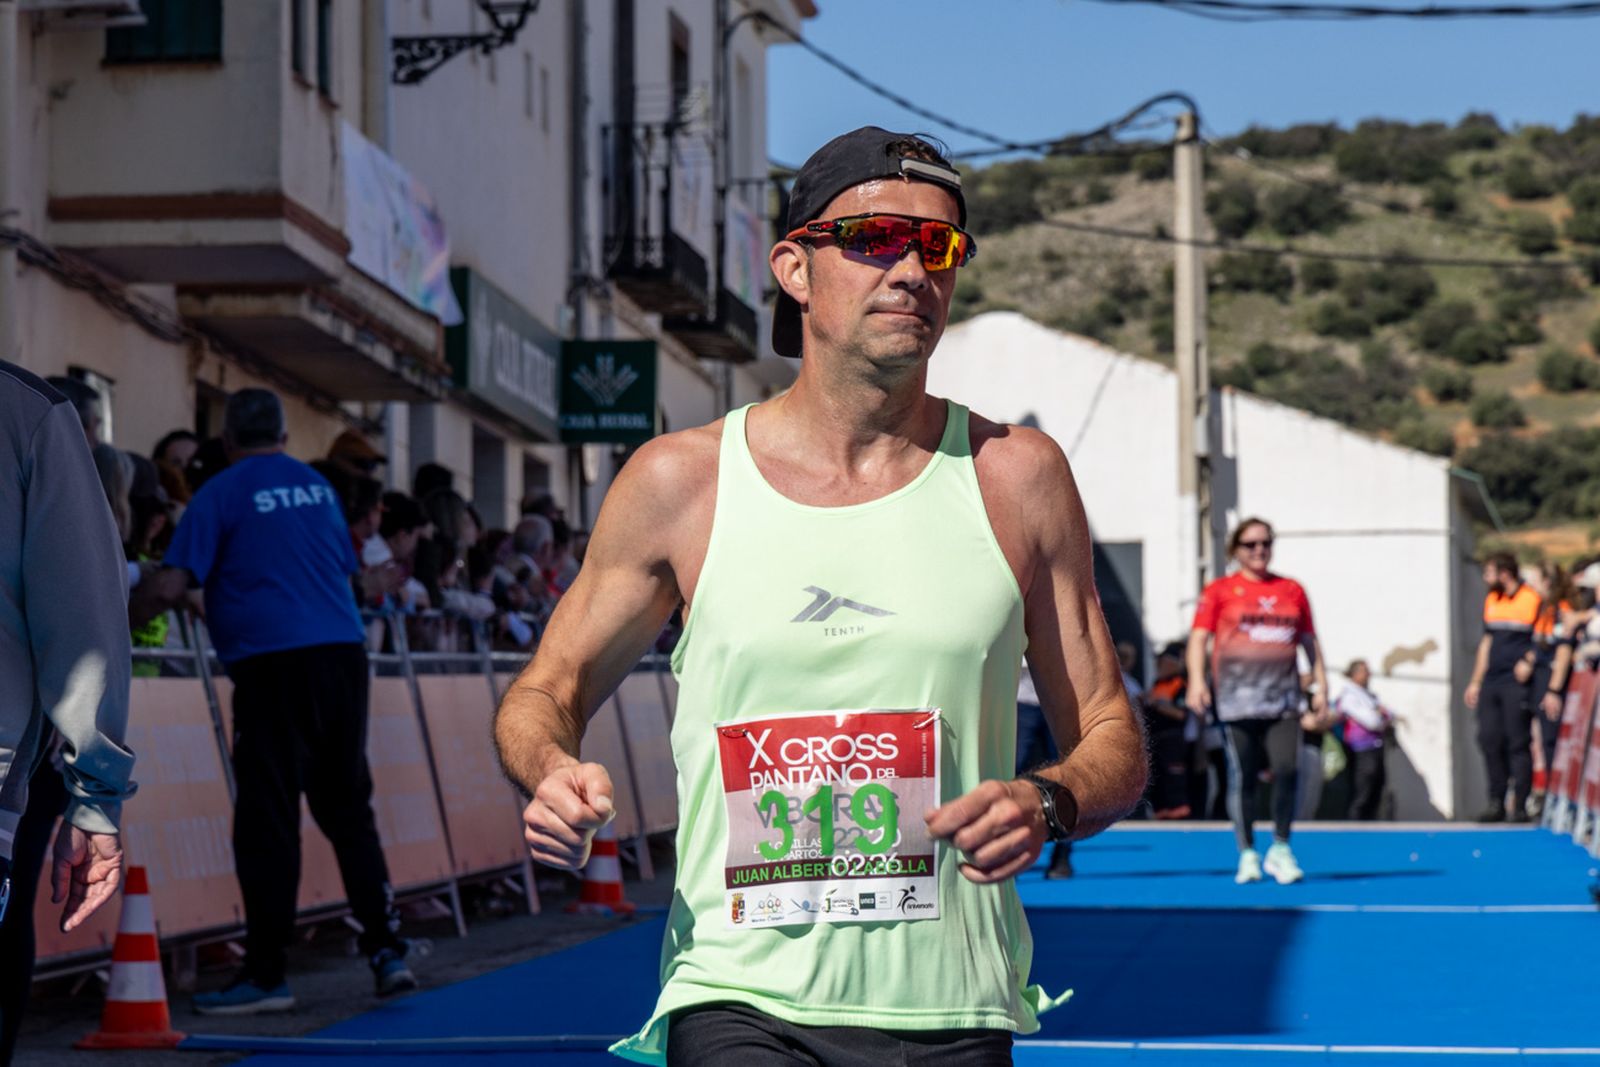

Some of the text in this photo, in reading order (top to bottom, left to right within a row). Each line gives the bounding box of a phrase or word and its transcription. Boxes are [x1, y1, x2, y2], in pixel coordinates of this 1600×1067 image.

[824, 625, 865, 637] TENTH
[747, 729, 774, 768] X
[780, 733, 899, 766] CROSS
[751, 763, 899, 796] PANTANO DEL
[759, 783, 898, 860] 319
[732, 866, 769, 884] JUAN
[772, 862, 848, 880] ALBERTO
